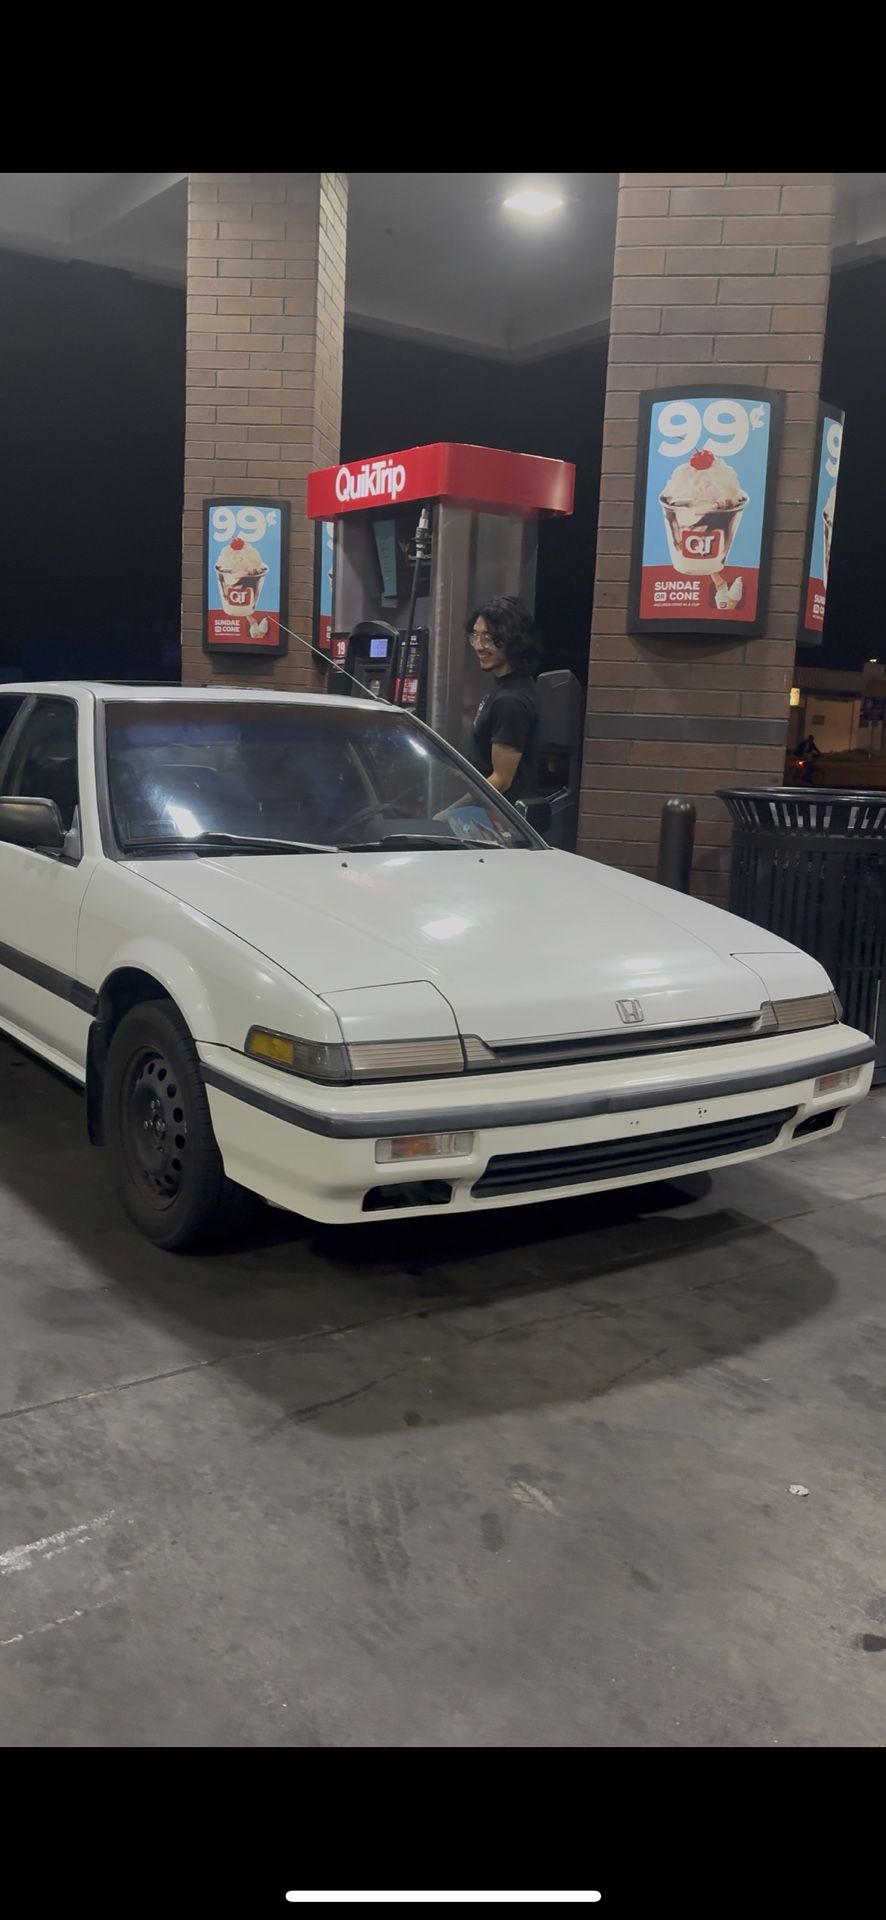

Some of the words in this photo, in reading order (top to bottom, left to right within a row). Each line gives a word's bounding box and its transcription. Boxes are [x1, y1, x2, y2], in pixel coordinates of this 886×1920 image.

[658, 401, 765, 457] 99¢
[335, 459, 406, 502] QuikTrip
[685, 535, 715, 555] QT
[654, 581, 701, 591] SUNDAE
[230, 591, 248, 604] QT
[669, 592, 700, 601] CONE
[336, 641, 346, 655] 19
